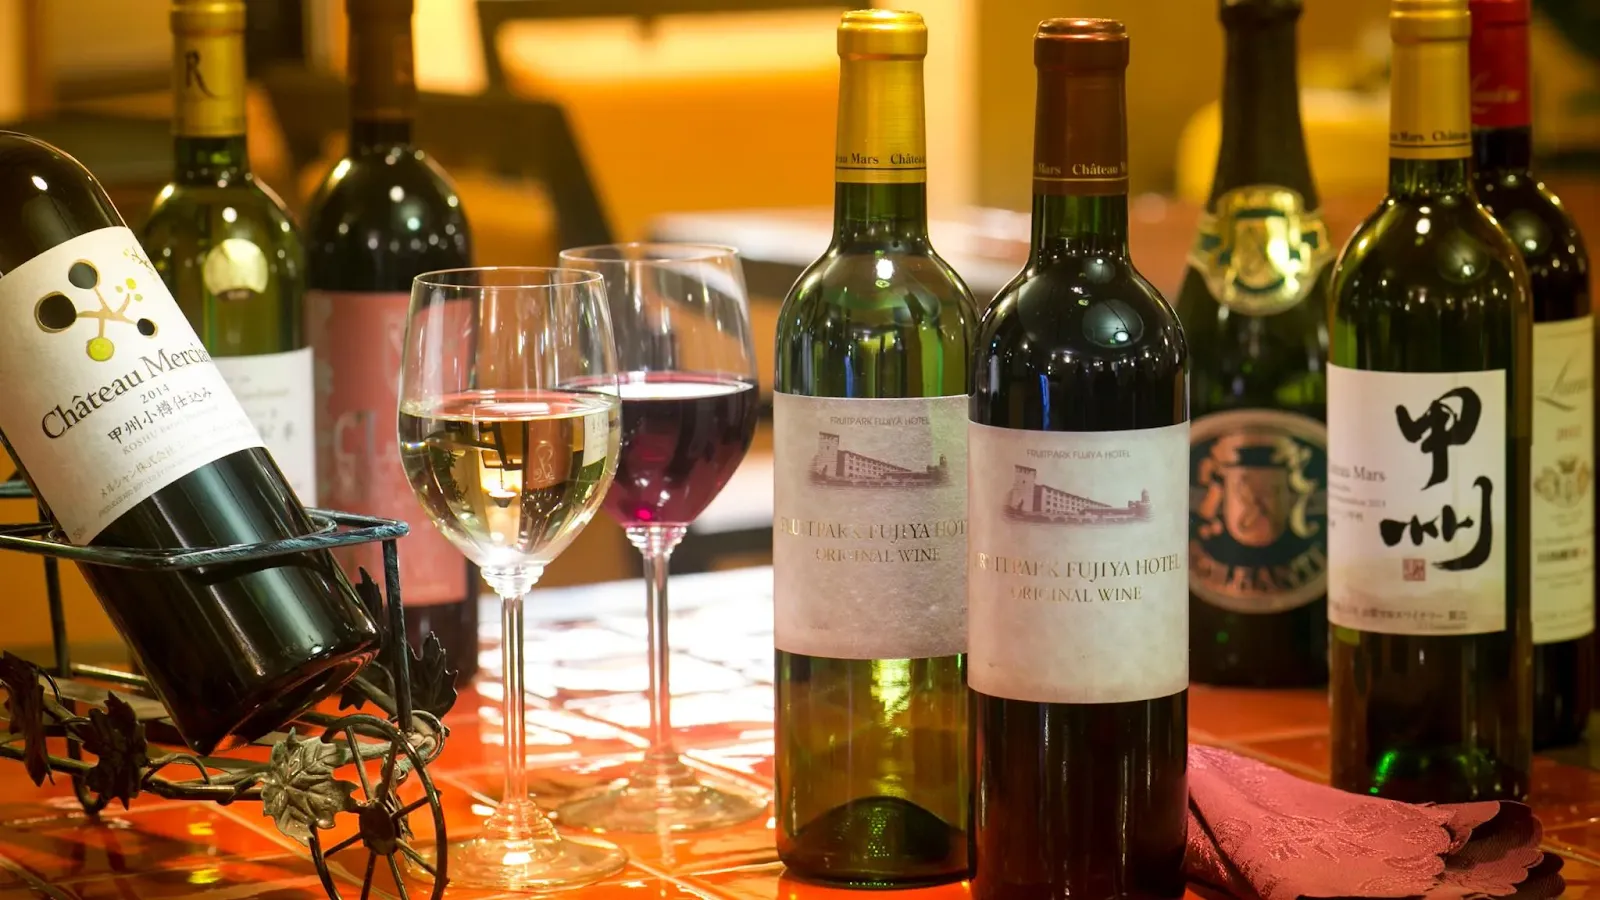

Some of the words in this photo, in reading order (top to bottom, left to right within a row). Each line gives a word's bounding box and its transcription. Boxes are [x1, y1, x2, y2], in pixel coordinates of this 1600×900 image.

[184, 50, 221, 99] R
[851, 153, 879, 165] Mars
[1072, 160, 1119, 175] Château
[42, 369, 144, 439] Château
[140, 383, 170, 405] 2014
[107, 387, 212, 445] 甲州小樽仕込み
[830, 416, 873, 426] FRUITPARK
[874, 417, 903, 426] FUJIYA
[905, 416, 931, 426] HOTEL
[1027, 449, 1071, 460] FRUITPARK
[1073, 450, 1103, 460] FUJIYA
[1105, 449, 1131, 460] HOTEL
[1379, 386, 1493, 572] 甲州
[780, 516, 862, 539] FRUTPARK
[869, 523, 930, 544] FUJIYA
[935, 519, 968, 538] HOT
[899, 548, 942, 562] WINE
[1067, 561, 1131, 583] FUJIYA
[1135, 553, 1181, 576] HOTEL
[1097, 586, 1143, 602] WINE
